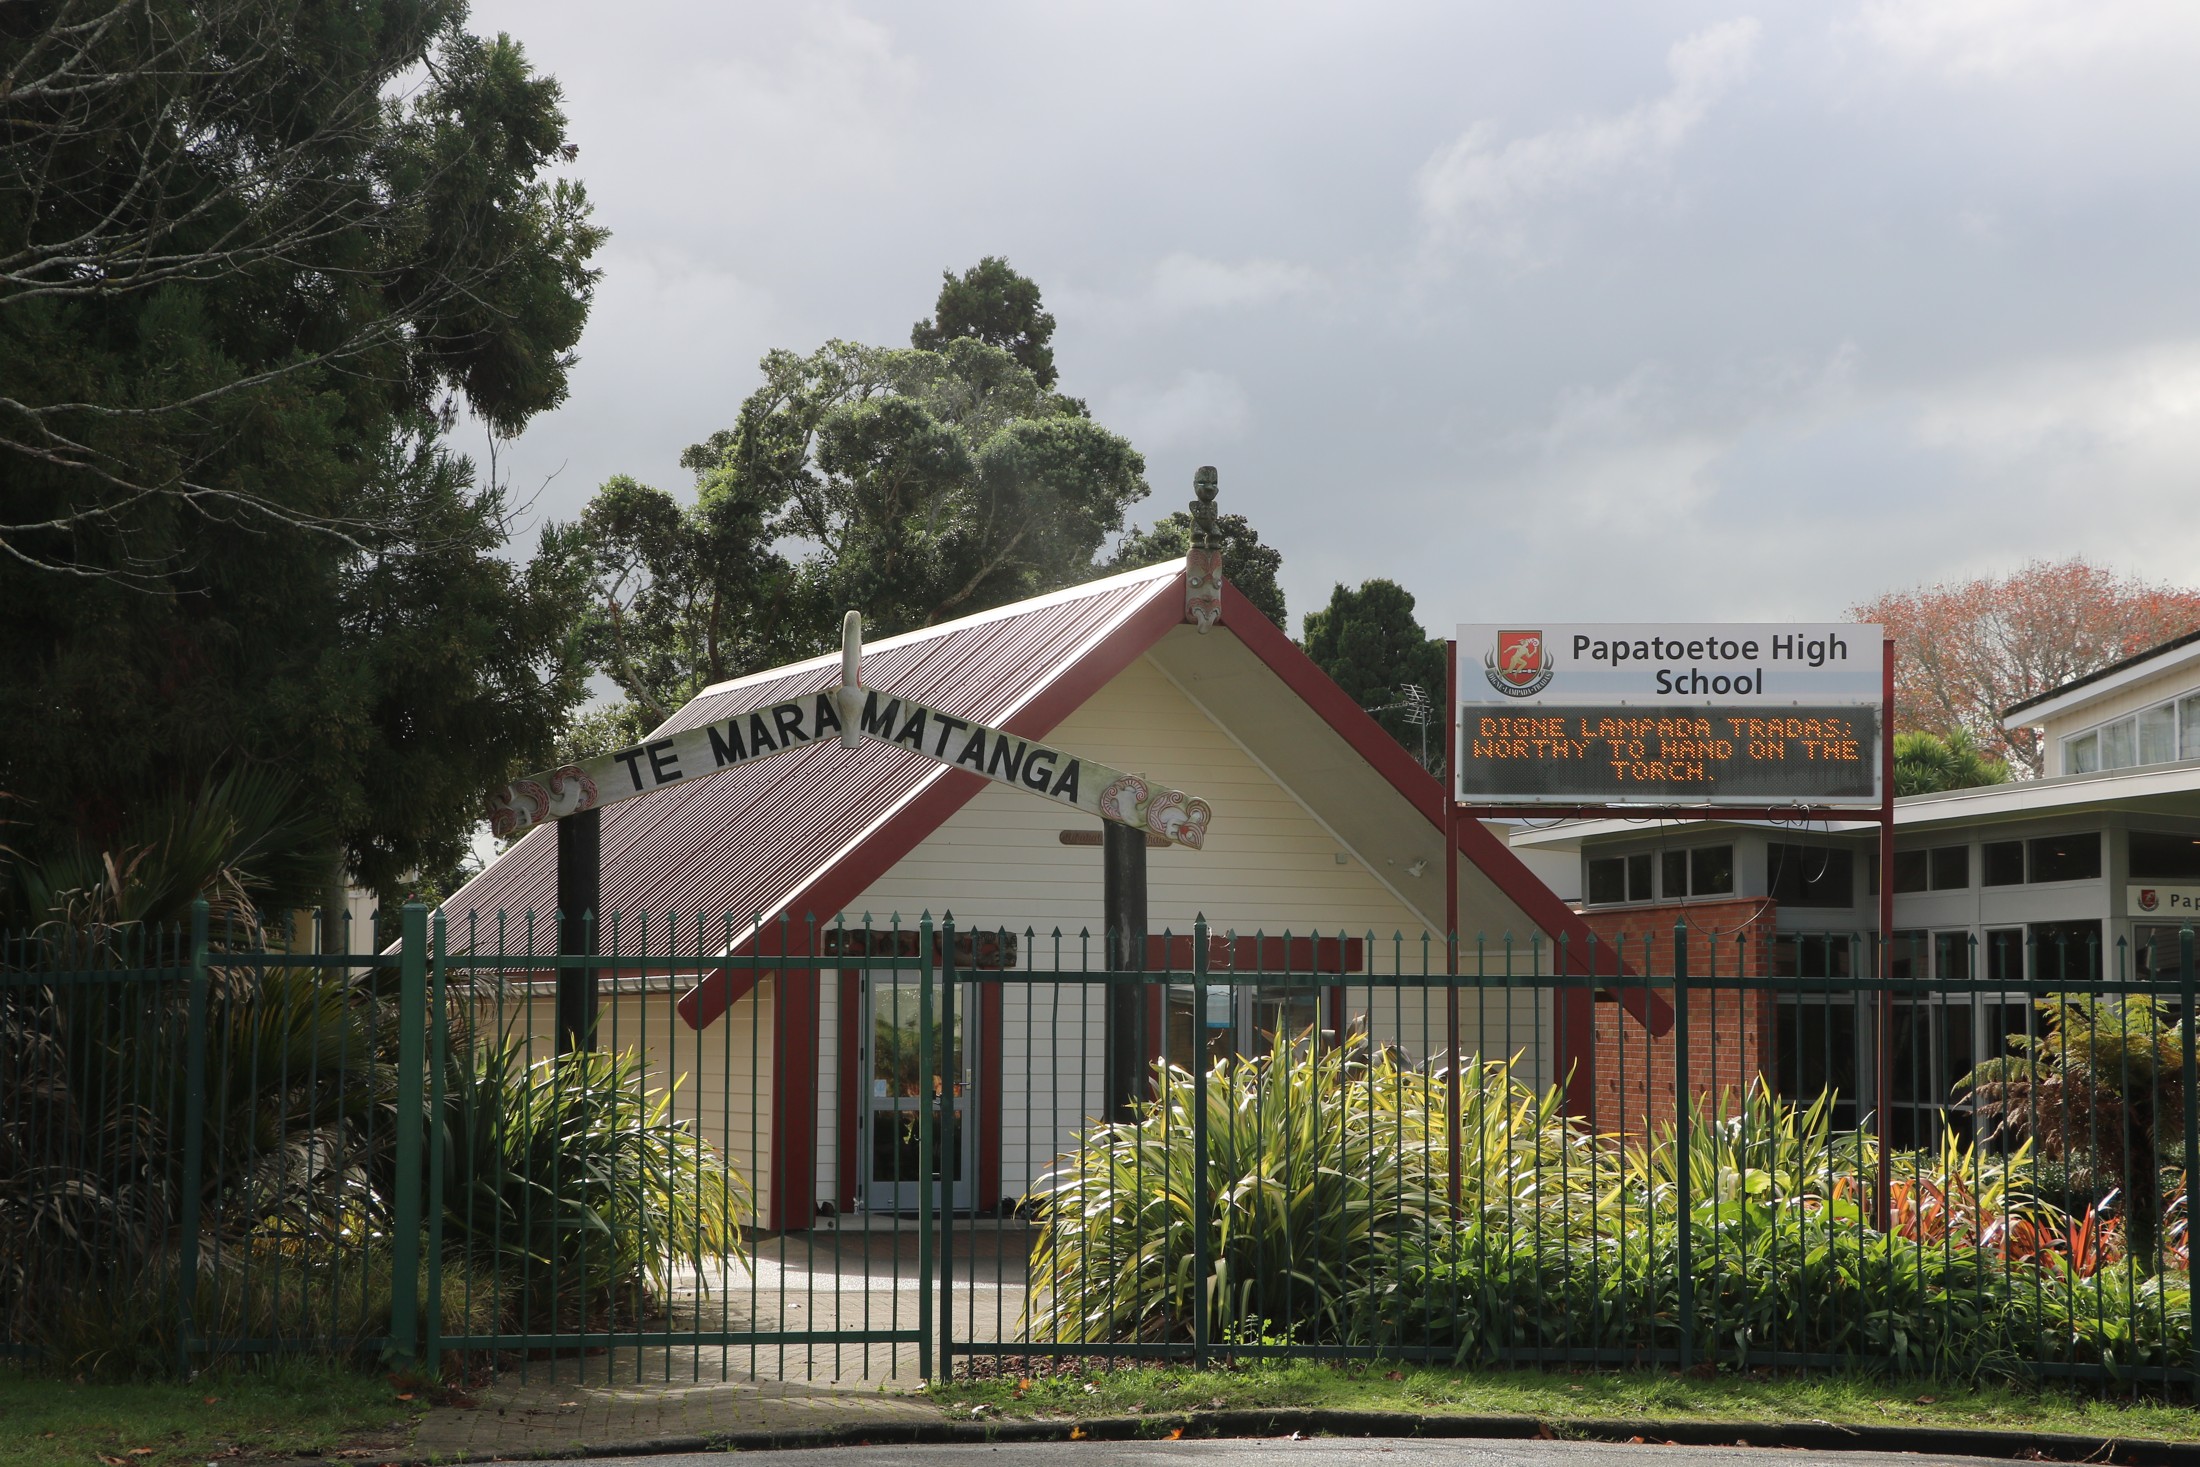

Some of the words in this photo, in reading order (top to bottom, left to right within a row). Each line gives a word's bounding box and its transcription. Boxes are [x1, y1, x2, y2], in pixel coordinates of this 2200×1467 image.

[1573, 635, 1760, 667] Papatoetoe
[1772, 633, 1848, 667] High
[1656, 668, 1763, 695] School
[1480, 717, 1566, 738] DIGNE
[1581, 717, 1711, 738] LAMPADA
[1473, 739, 1591, 759] WORTHY
[1607, 739, 1646, 759] TO
[1661, 739, 1733, 760] HAND
[1749, 740, 1785, 760] ON
[1801, 740, 1860, 760] THE
[613, 738, 684, 792] TE
[1610, 761, 1714, 781] TORCH.
